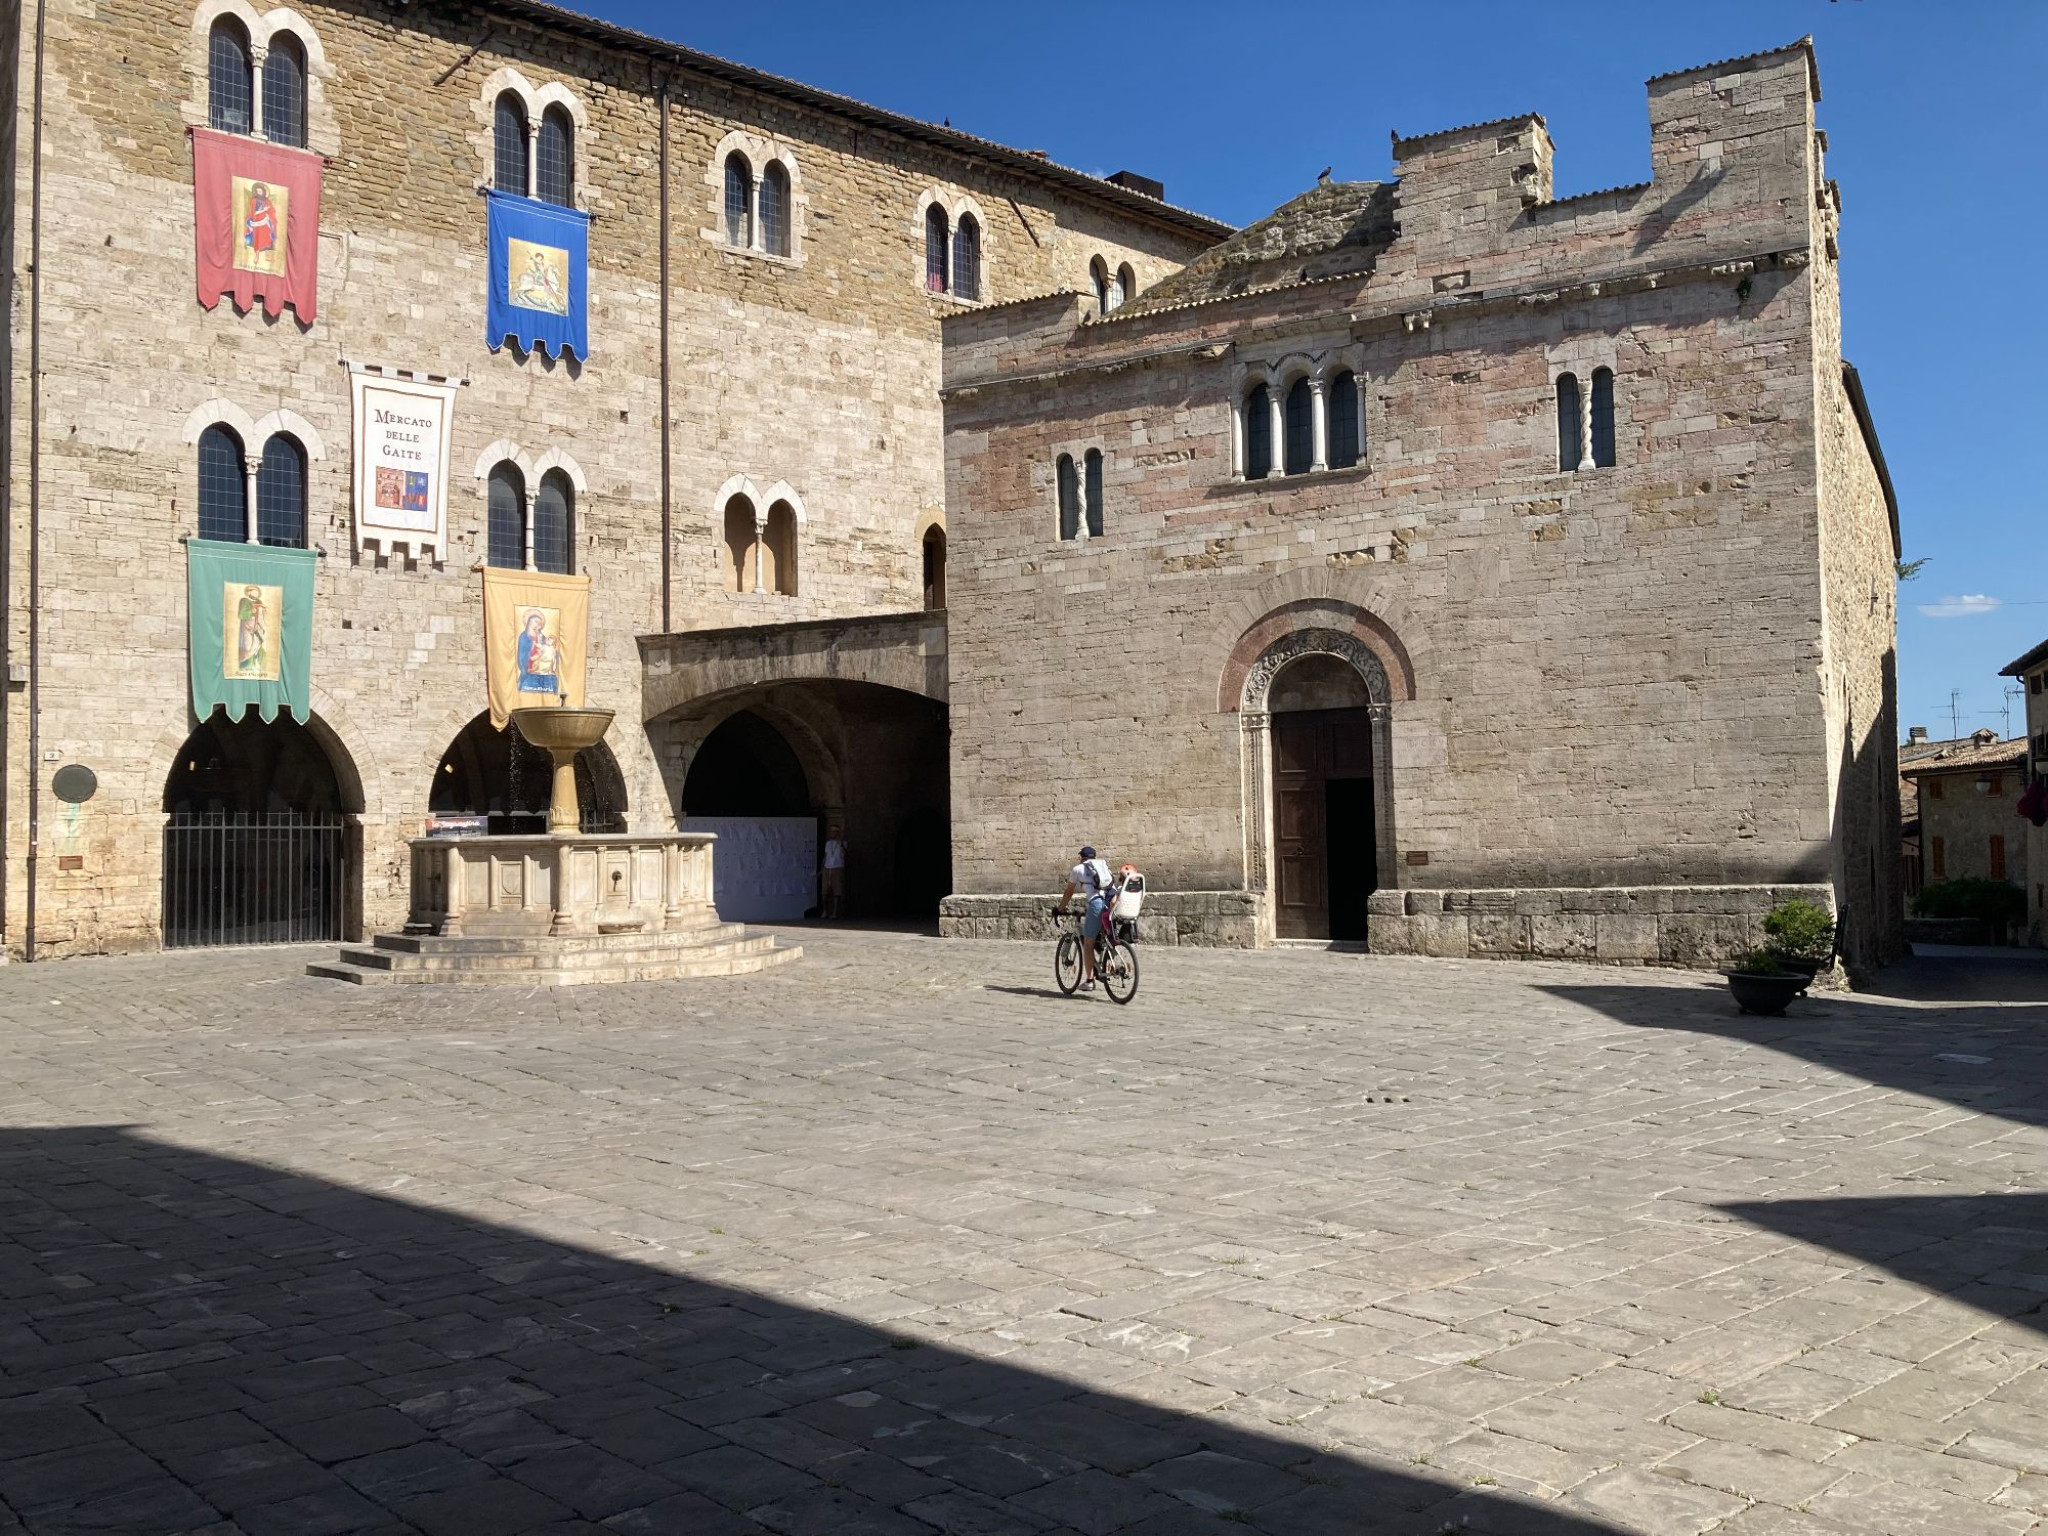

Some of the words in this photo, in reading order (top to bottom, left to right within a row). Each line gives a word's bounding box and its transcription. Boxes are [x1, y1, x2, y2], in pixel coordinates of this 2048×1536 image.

[373, 408, 432, 428] MERCATO
[385, 430, 420, 443] DELLE
[382, 444, 422, 460] GAITE
